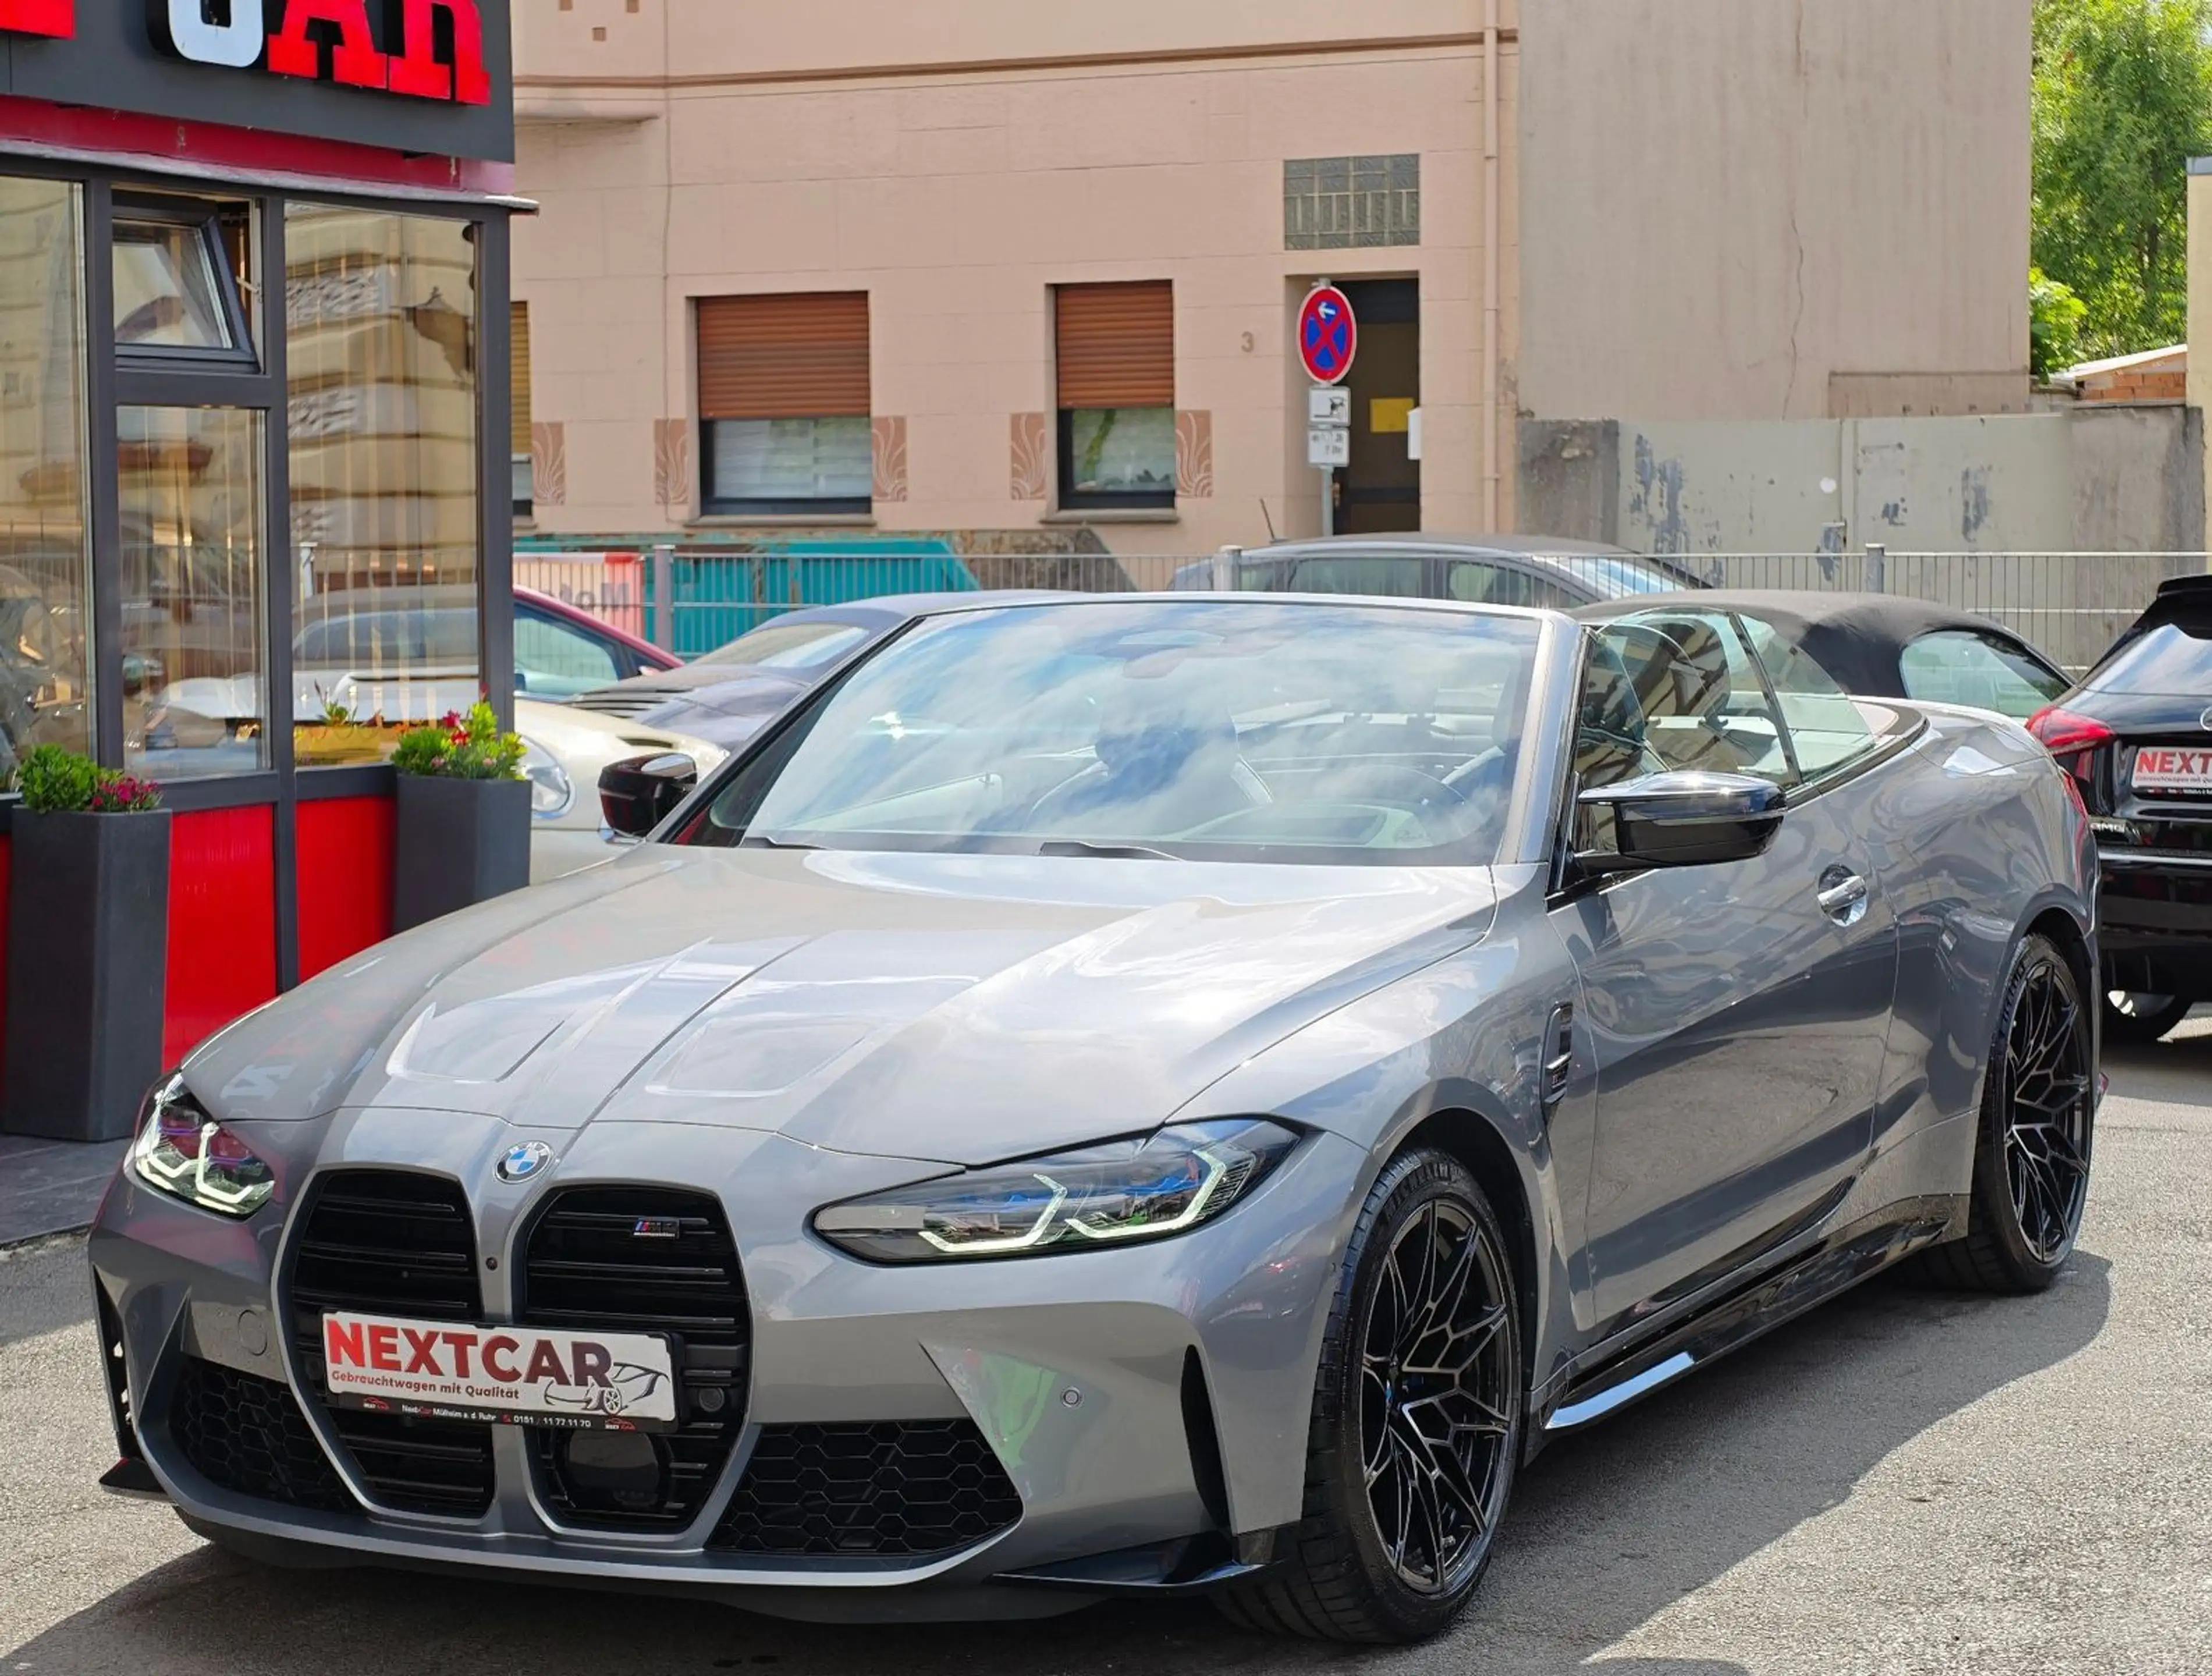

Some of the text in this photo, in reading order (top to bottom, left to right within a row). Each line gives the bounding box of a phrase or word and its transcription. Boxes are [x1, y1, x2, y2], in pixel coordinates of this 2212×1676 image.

[1241, 331, 1254, 353] 3
[326, 1319, 612, 1387] NEXTCAR
[331, 1370, 436, 1392] Gebrauchtwagen
[440, 1382, 461, 1394] mit
